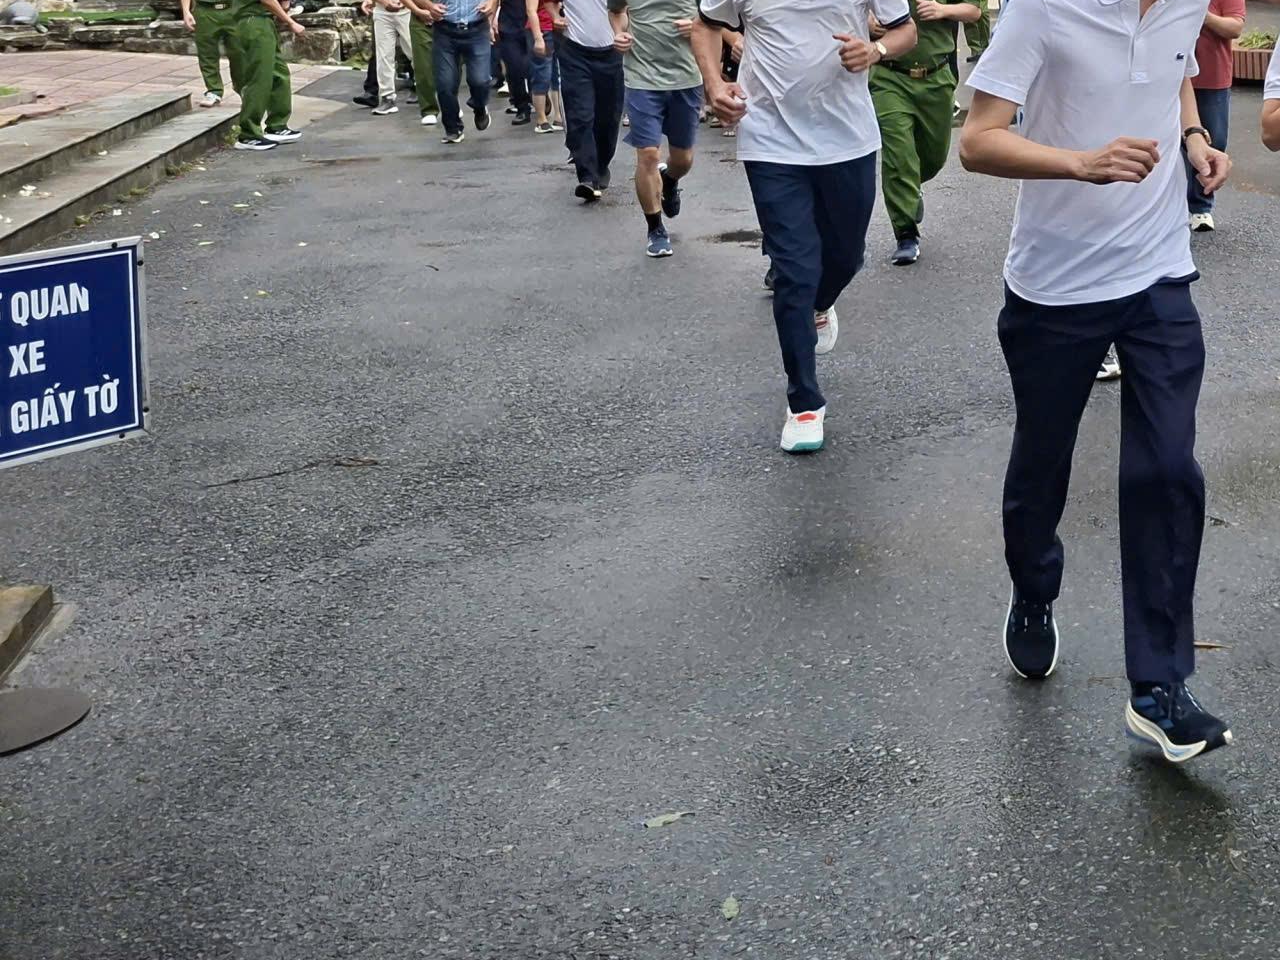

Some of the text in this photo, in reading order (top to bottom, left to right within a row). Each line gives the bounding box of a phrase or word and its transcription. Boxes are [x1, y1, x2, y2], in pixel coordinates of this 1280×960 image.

[11, 282, 89, 327] QUAN
[8, 340, 46, 378] XE
[10, 374, 119, 434] GIẤY TỜ
